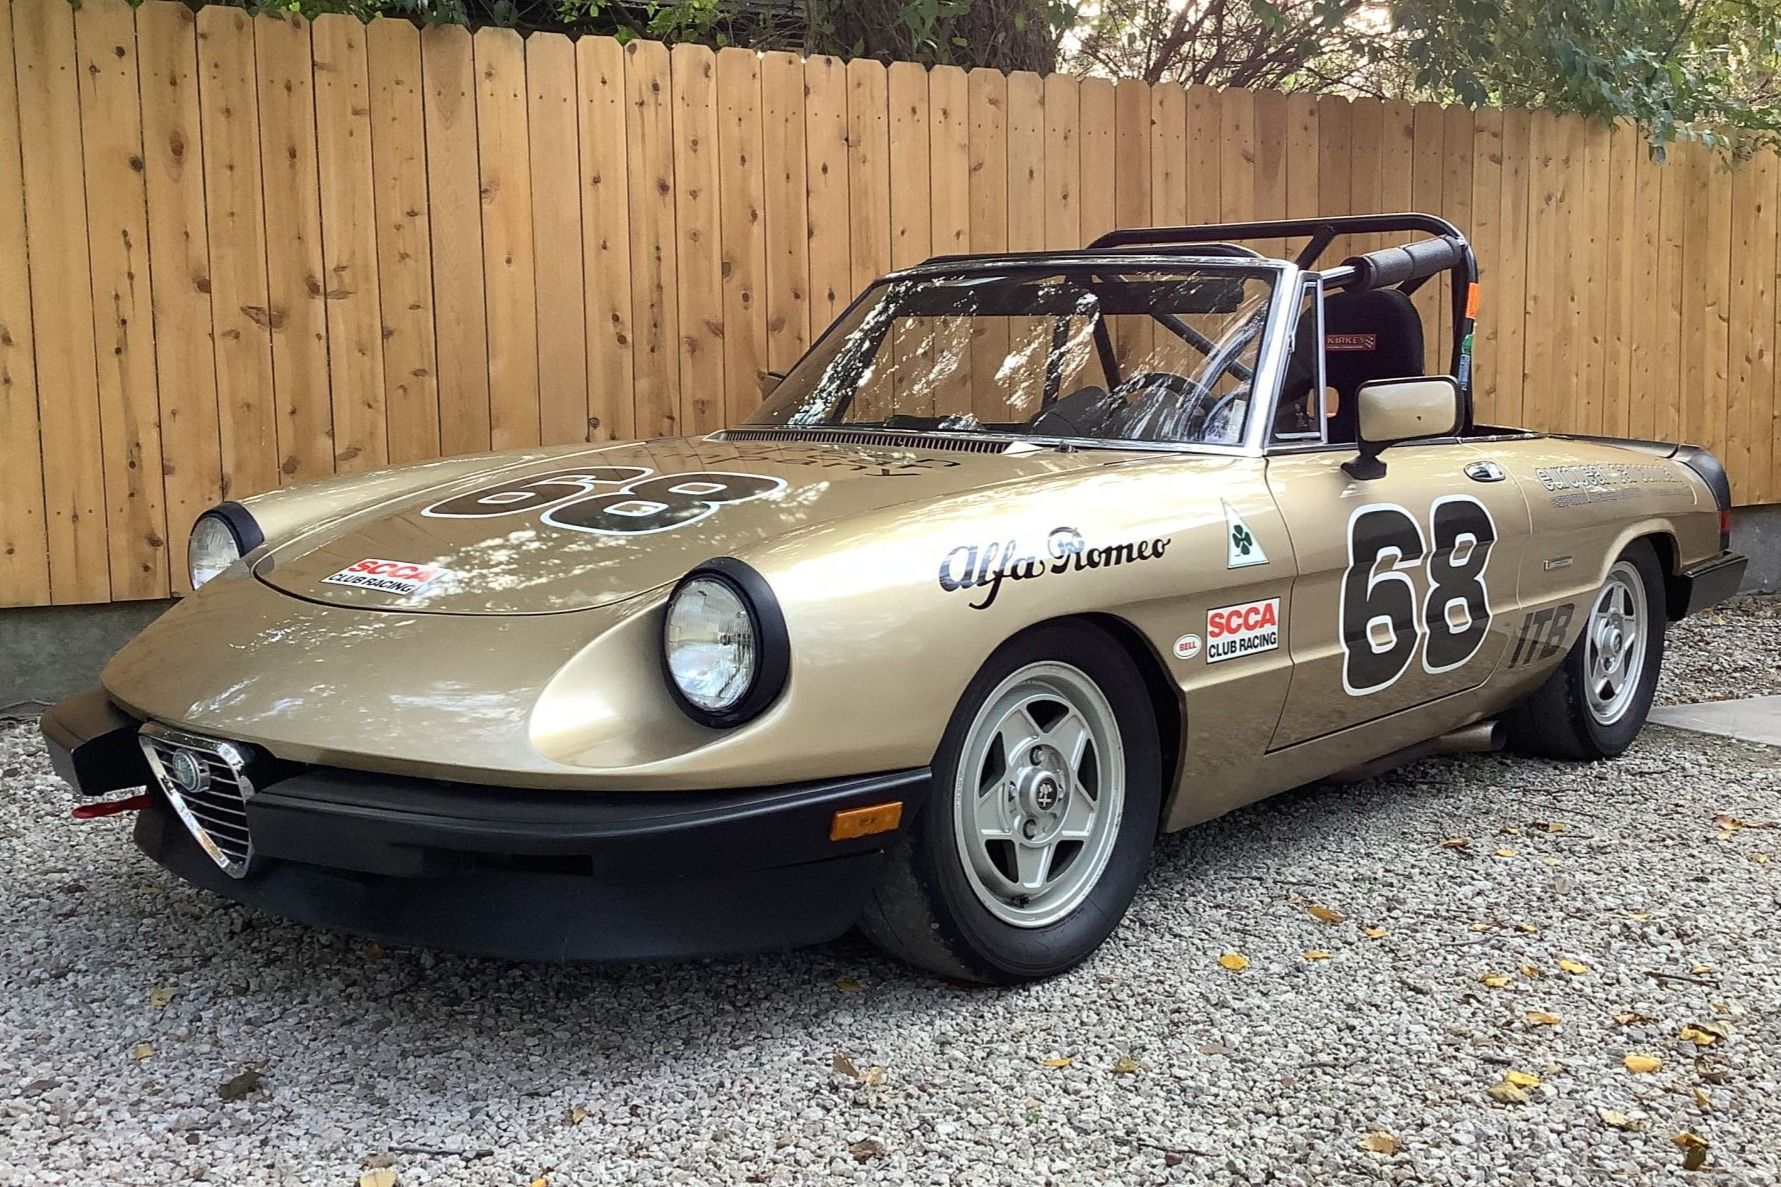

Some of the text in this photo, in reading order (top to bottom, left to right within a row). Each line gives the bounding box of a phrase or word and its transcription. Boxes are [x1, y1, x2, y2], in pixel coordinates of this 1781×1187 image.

[1327, 336, 1364, 344] KIRKEY
[420, 466, 789, 535] 68
[328, 573, 416, 593] CLUB RACING
[347, 560, 434, 583] SCCA
[938, 526, 1171, 610] Alfa Romeo
[1339, 494, 1498, 697] 68
[1208, 603, 1276, 638] SCCA
[1508, 602, 1576, 669] ITB
[1179, 640, 1197, 652] BELL
[1208, 632, 1277, 658] CLUB RACING
